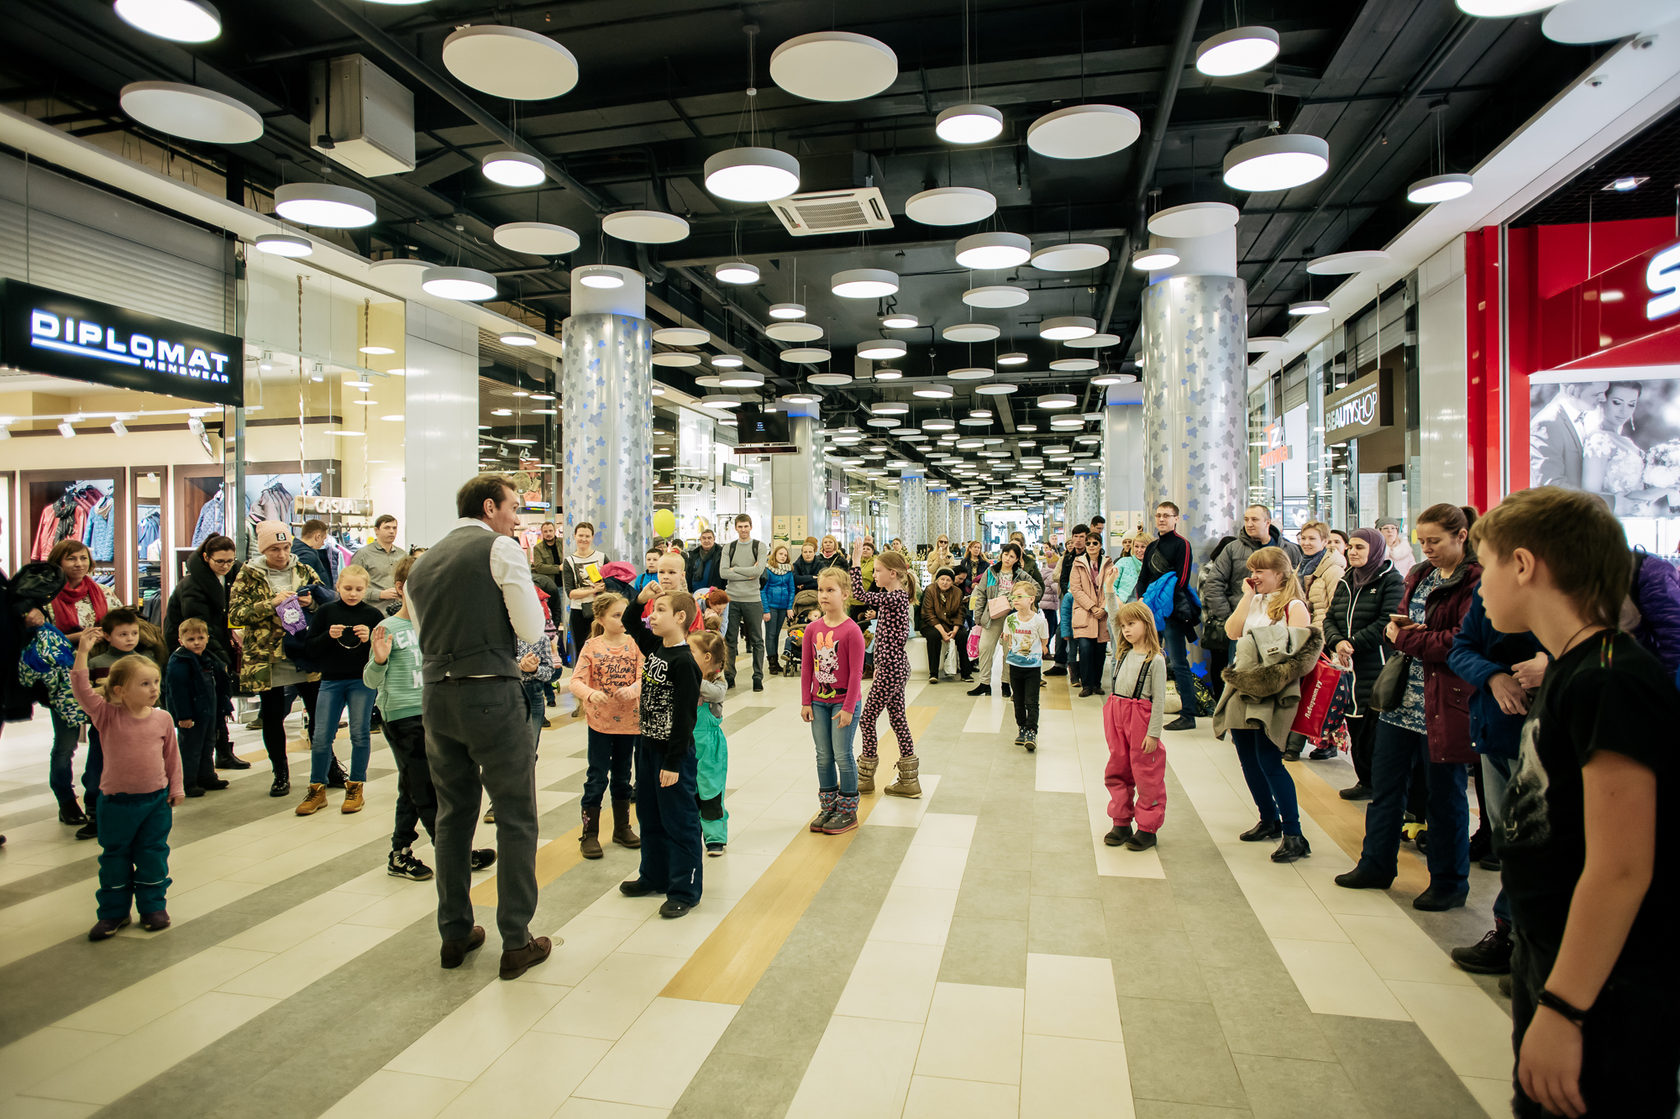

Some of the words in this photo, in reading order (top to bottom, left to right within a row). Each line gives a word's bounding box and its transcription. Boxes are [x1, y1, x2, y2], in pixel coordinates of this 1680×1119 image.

[31, 308, 229, 373] DIPLOMAT
[144, 358, 229, 384] MENSWEAR
[315, 499, 361, 514] CASUAL
